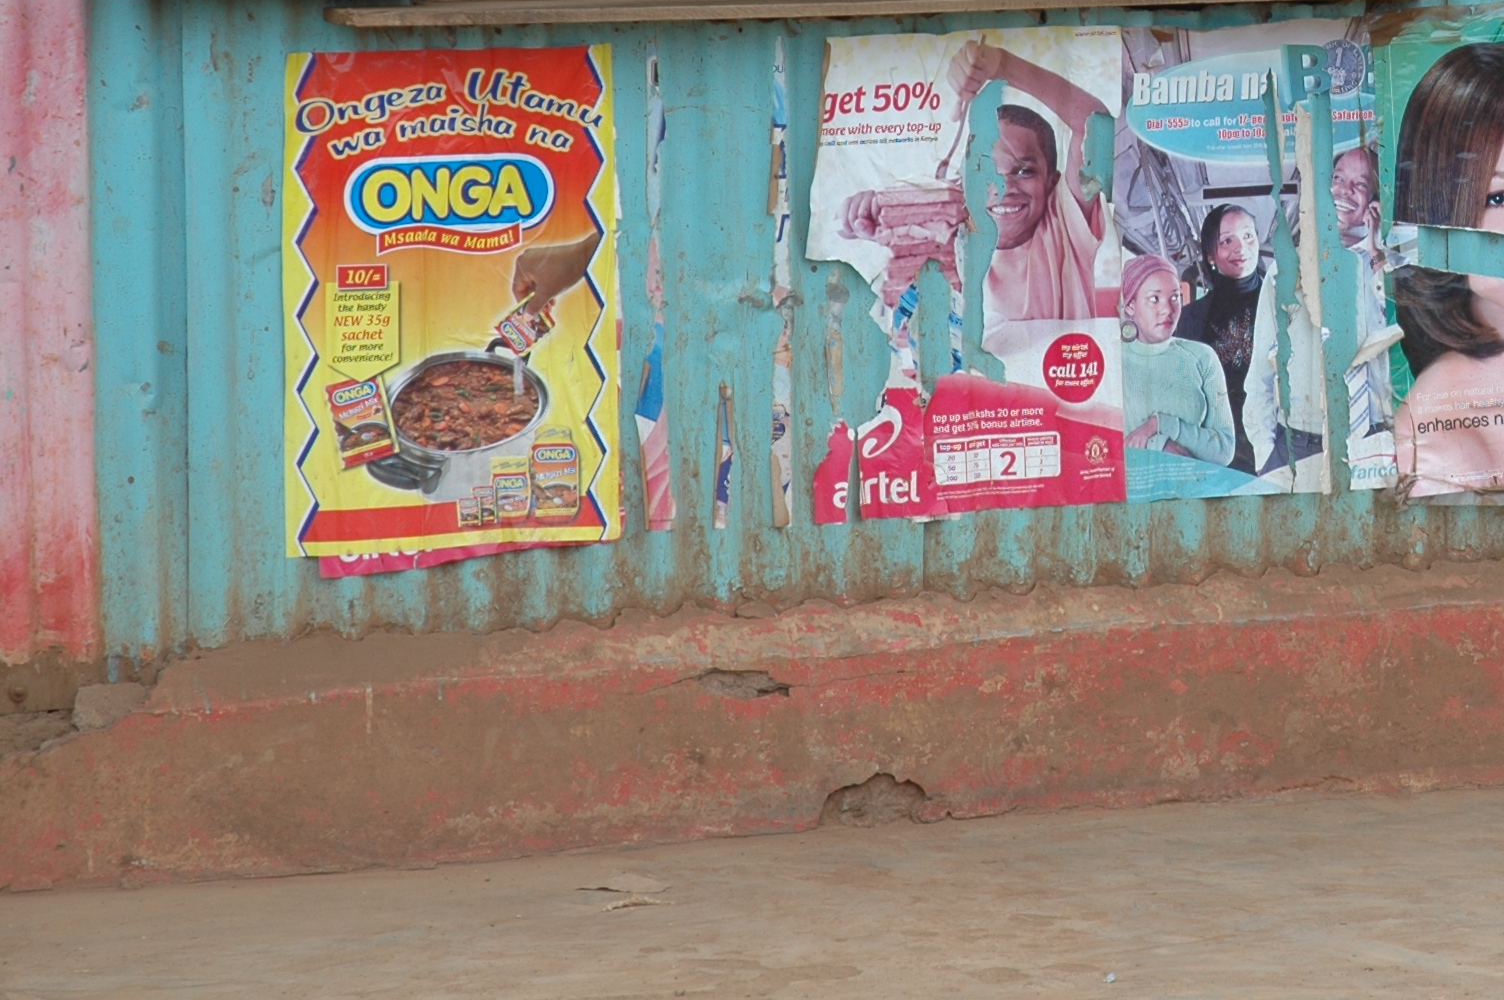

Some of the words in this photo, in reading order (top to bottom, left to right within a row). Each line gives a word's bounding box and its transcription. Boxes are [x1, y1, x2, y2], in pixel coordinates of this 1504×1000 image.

[1133, 71, 1234, 106] Bamba
[295, 83, 445, 134] Ongeza
[465, 68, 604, 128] Utamu
[823, 85, 866, 123] get
[872, 82, 940, 112] 50%
[330, 128, 384, 159] wa
[398, 104, 516, 141] maisha
[527, 126, 573, 151] na
[848, 123, 872, 135] with
[875, 123, 904, 135] every
[907, 122, 941, 132] top-up
[361, 163, 533, 223] ONGA
[384, 228, 437, 247] Msaada
[441, 232, 459, 245] wa
[464, 231, 514, 249] Mama!
[346, 270, 381, 284] 10/=
[333, 292, 390, 302] Introducing
[338, 302, 353, 312] the
[356, 302, 387, 314] handy
[333, 315, 363, 327] NEW
[367, 315, 390, 329] 35g
[341, 329, 383, 341] sachet
[342, 342, 355, 354] for
[359, 343, 383, 352] more
[332, 352, 392, 364] convenience!
[1049, 363, 1076, 378] call
[1079, 361, 1098, 377] 141
[335, 382, 374, 403] ONGA
[1417, 414, 1489, 434] enhances
[537, 449, 573, 461] ONGA
[1000, 451, 1017, 476] 2
[832, 473, 921, 507] airtel
